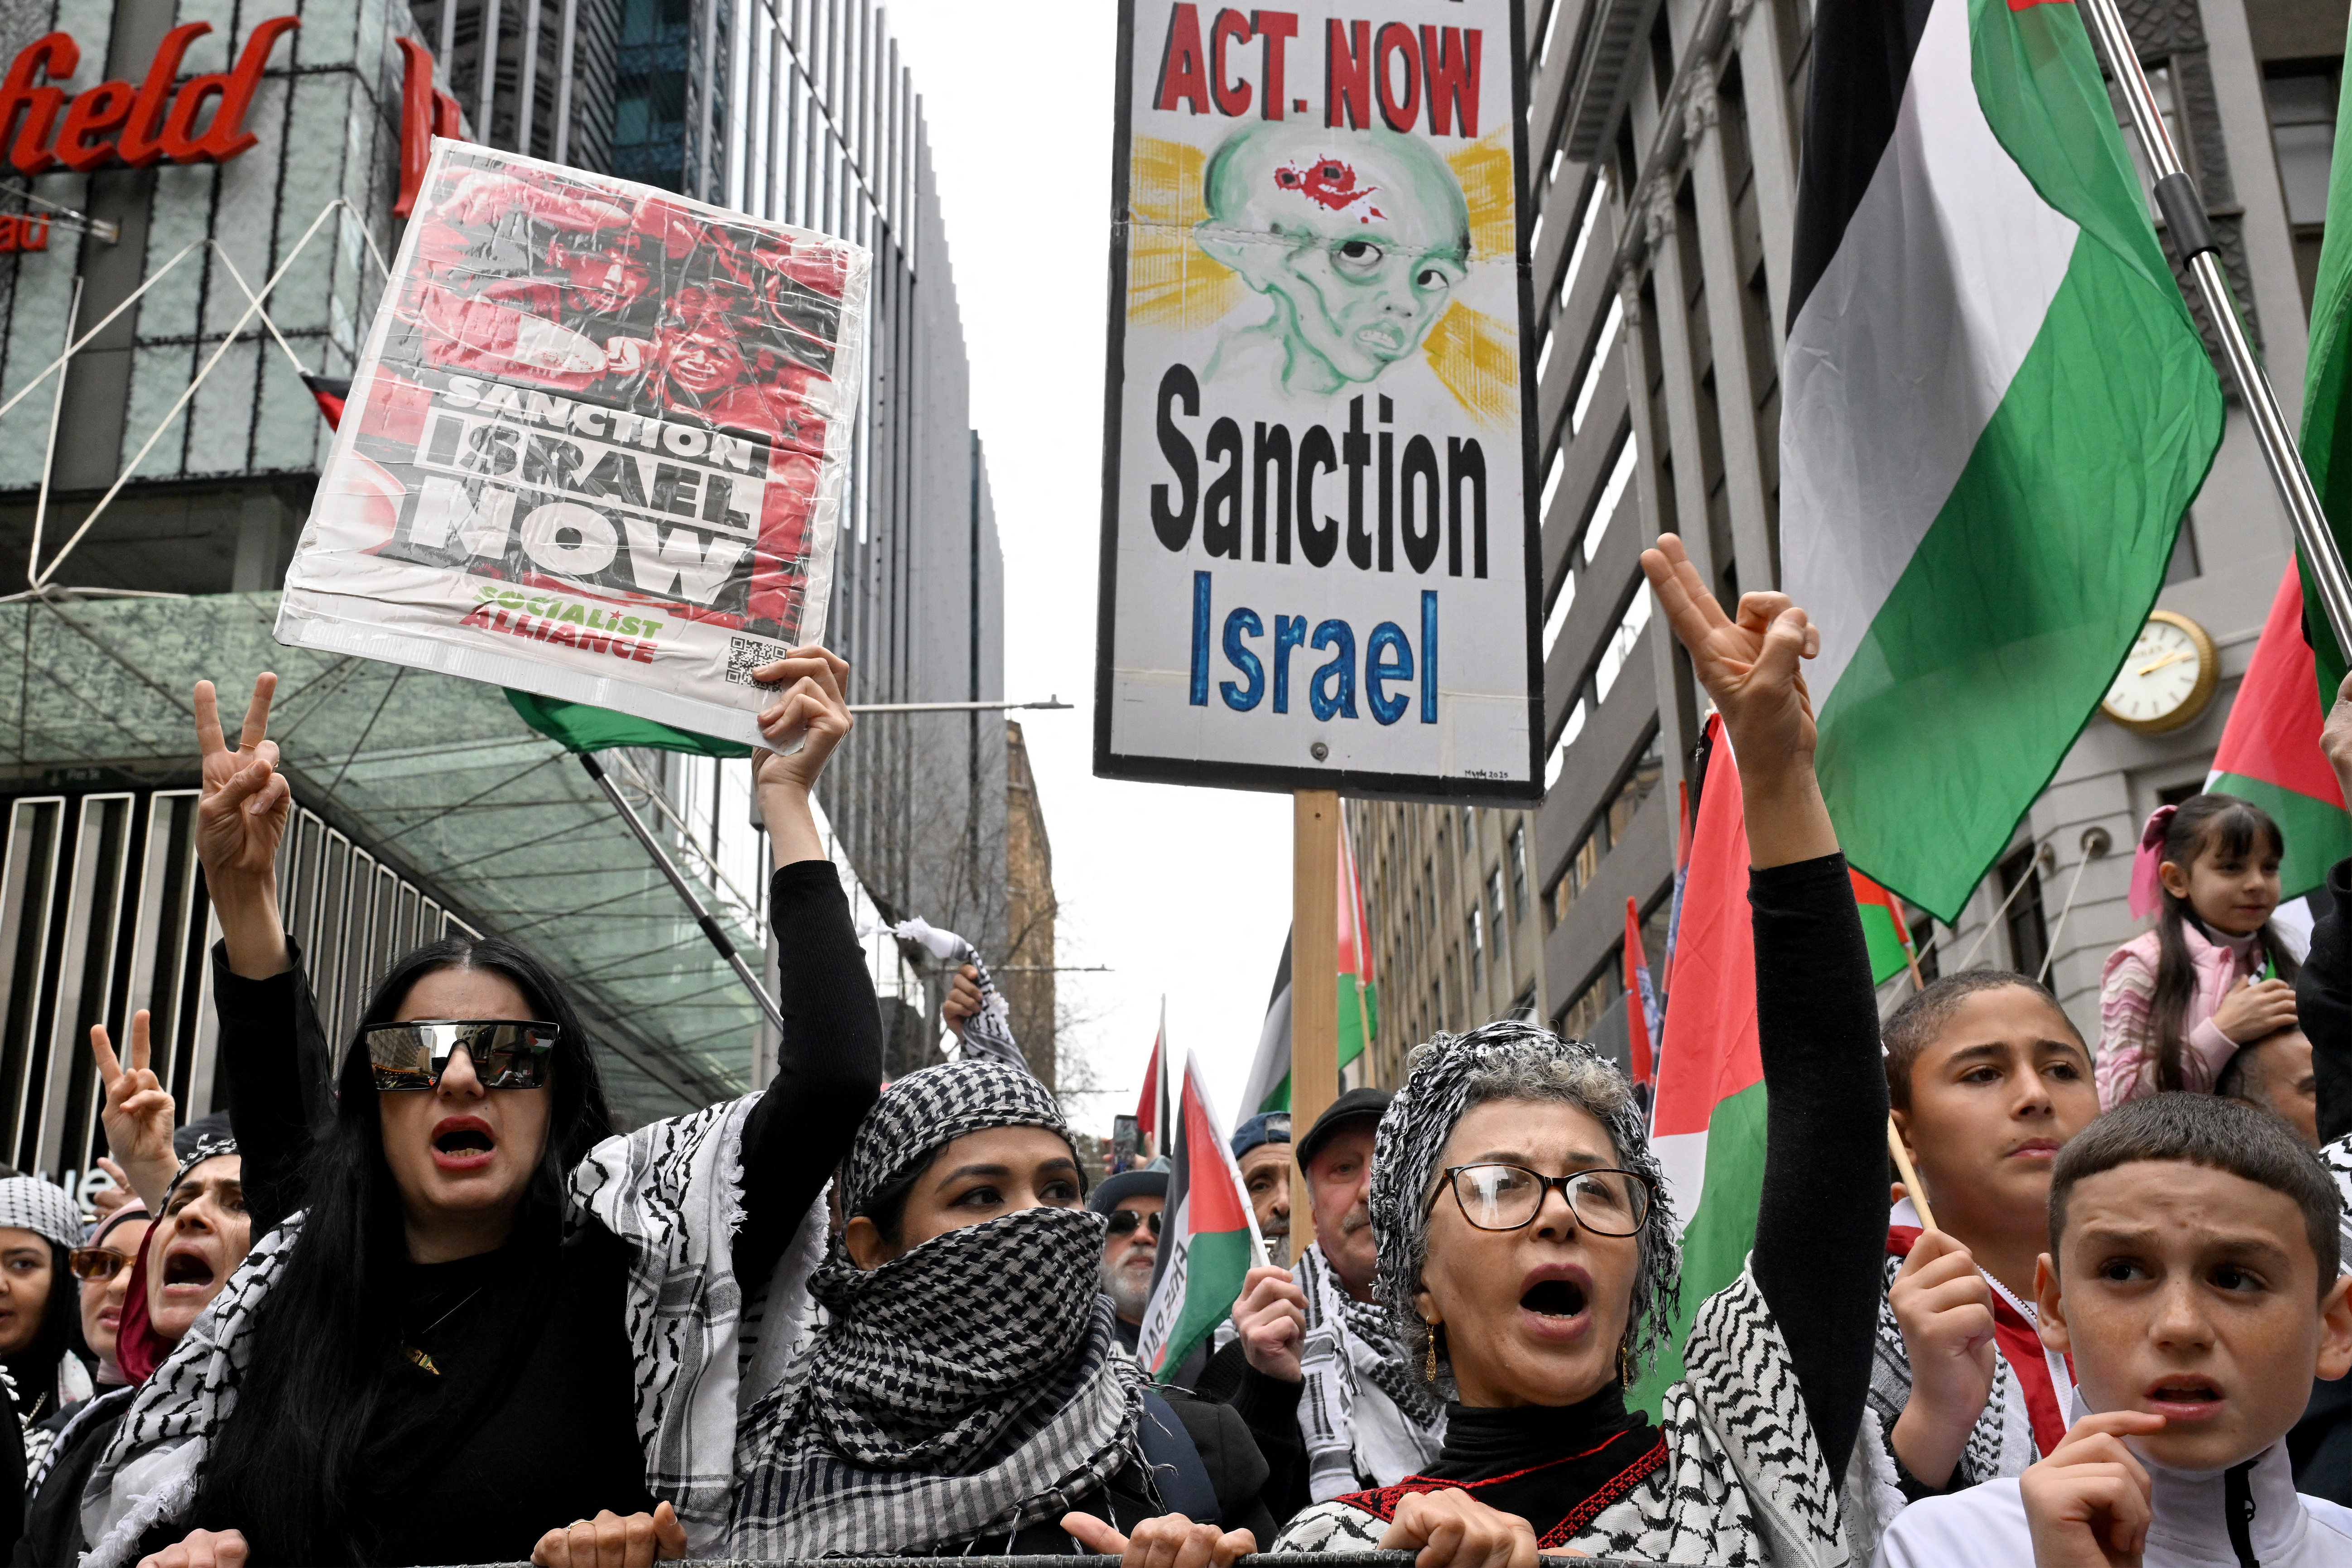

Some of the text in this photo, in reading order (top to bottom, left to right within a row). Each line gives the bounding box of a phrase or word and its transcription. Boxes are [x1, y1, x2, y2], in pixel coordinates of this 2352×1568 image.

[1325, 18, 1482, 138] NOW
[426, 414, 750, 529] ISRAEL
[442, 374, 753, 472] SANCTION
[1151, 363, 1487, 578] Sanction
[413, 476, 751, 605] NOW
[459, 605, 659, 664] ALLIANCE
[1189, 571, 1438, 726] Israel
